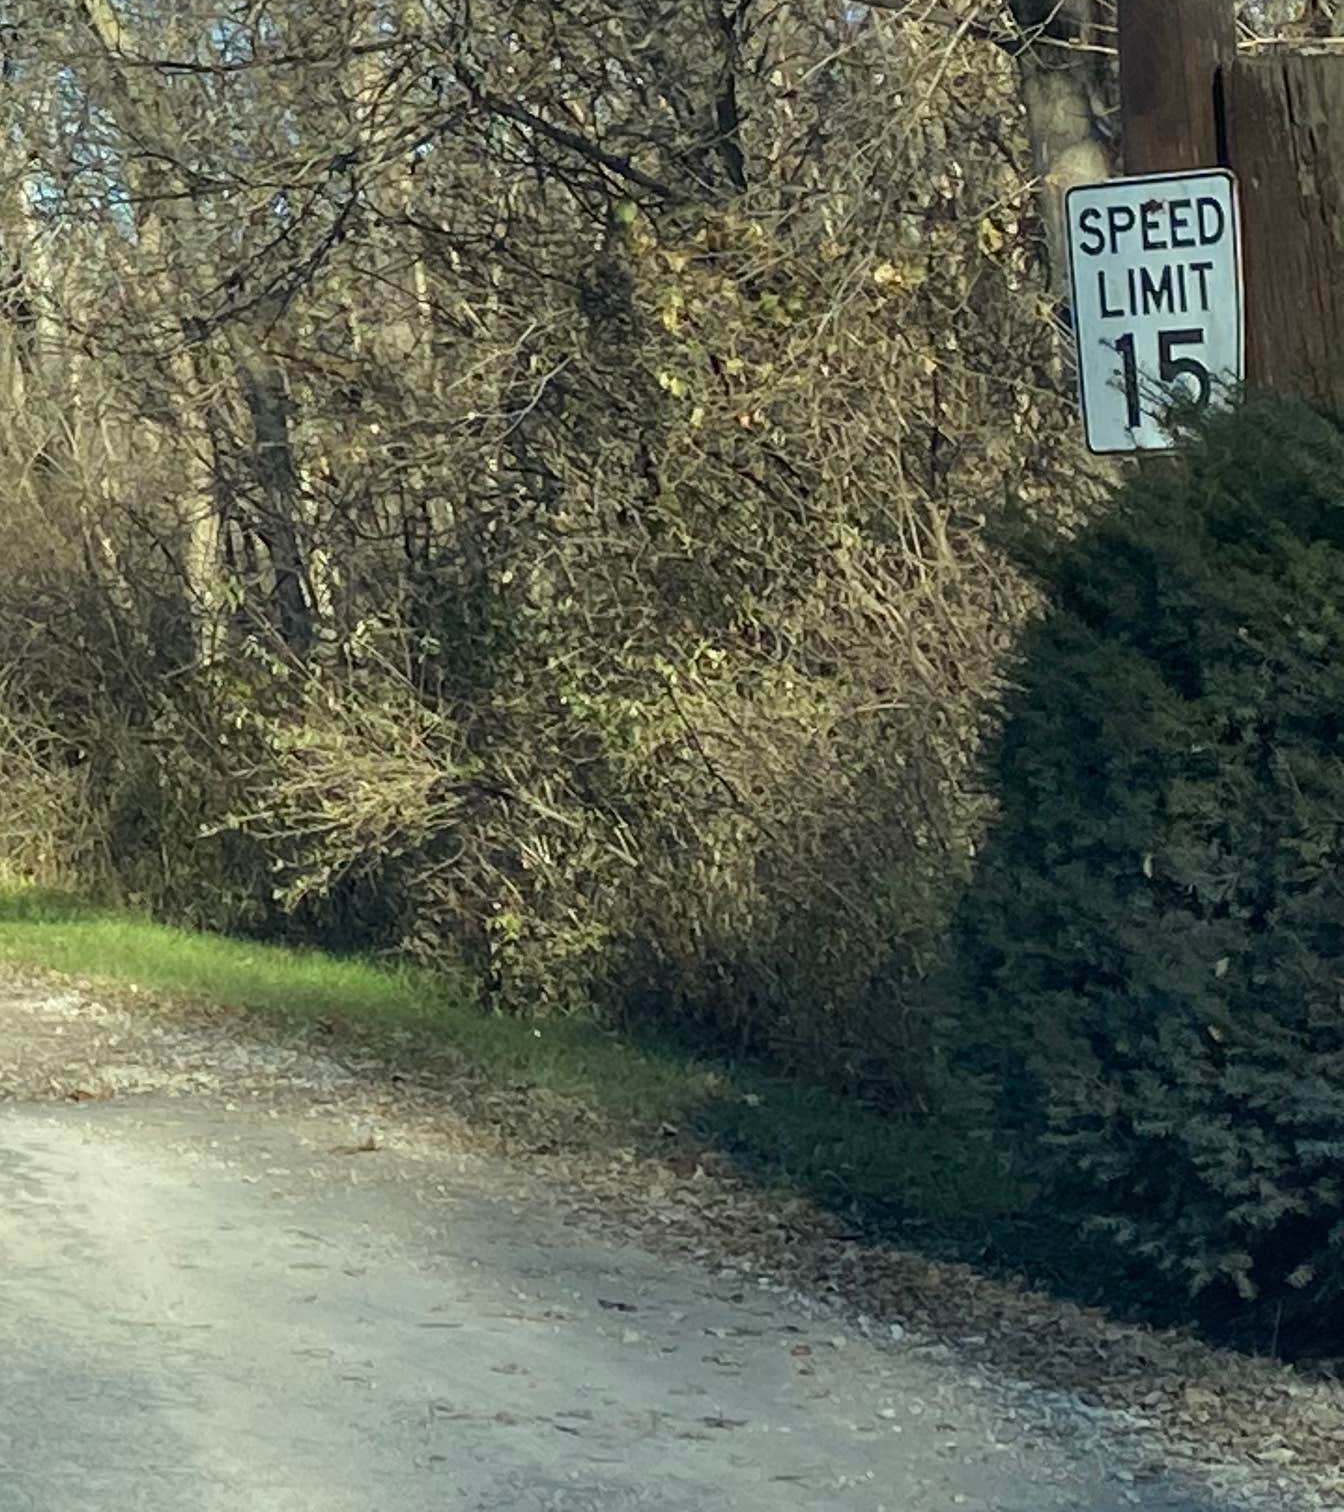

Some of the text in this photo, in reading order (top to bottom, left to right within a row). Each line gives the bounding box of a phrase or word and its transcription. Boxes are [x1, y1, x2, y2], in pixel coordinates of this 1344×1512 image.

[1078, 196, 1226, 257] SPEED
[1097, 261, 1214, 320] LIMIT
[1114, 327, 1211, 428] 15
